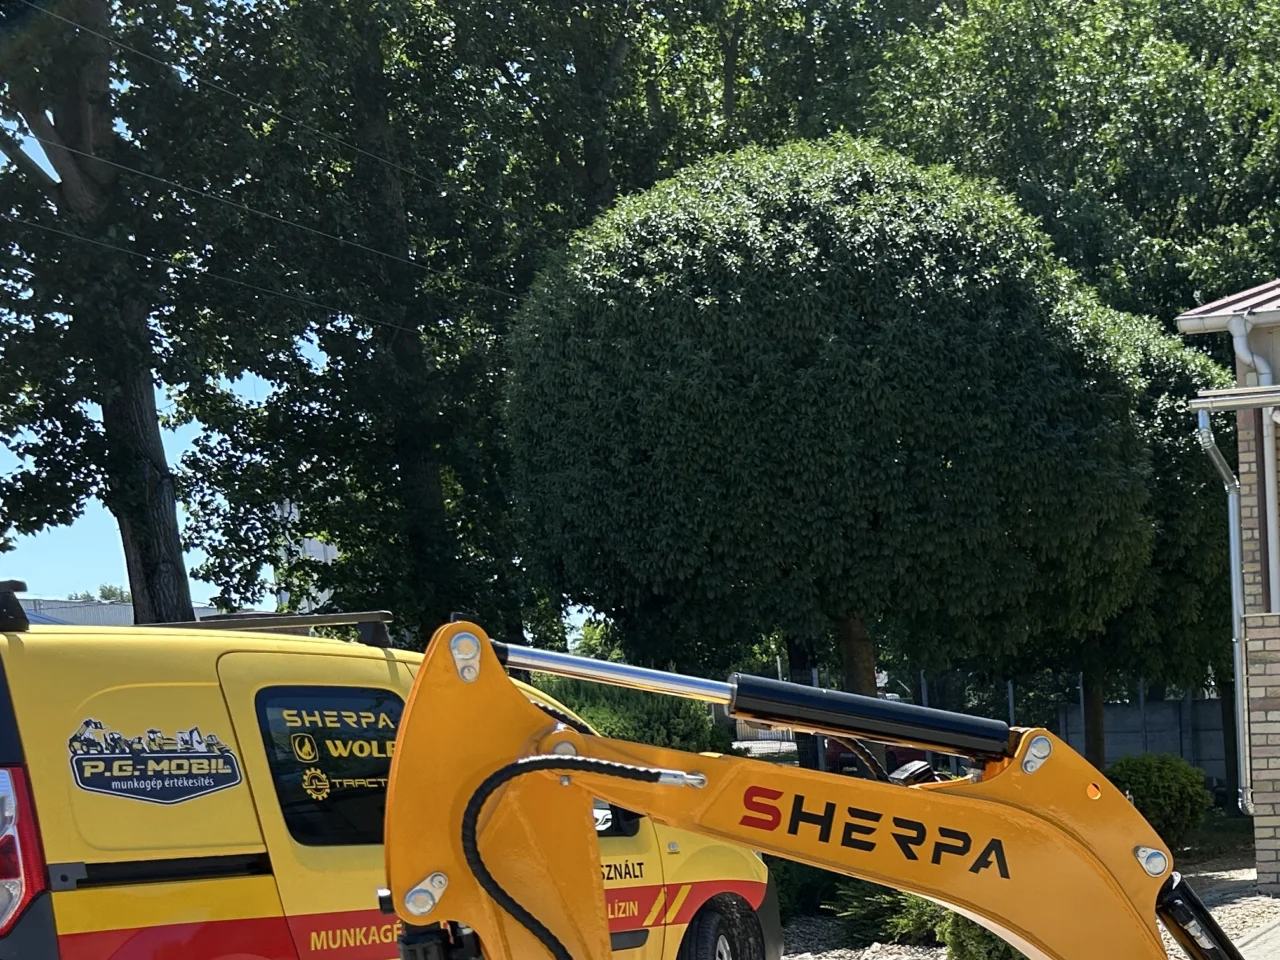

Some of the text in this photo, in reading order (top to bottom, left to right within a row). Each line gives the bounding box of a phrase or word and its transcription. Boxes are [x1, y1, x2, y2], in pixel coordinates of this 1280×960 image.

[282, 709, 395, 729] SHERPA
[82, 758, 232, 778] P.G.-MOBIL
[111, 776, 215, 791] munkagép értékesítés
[738, 785, 1011, 879] SHERPA
